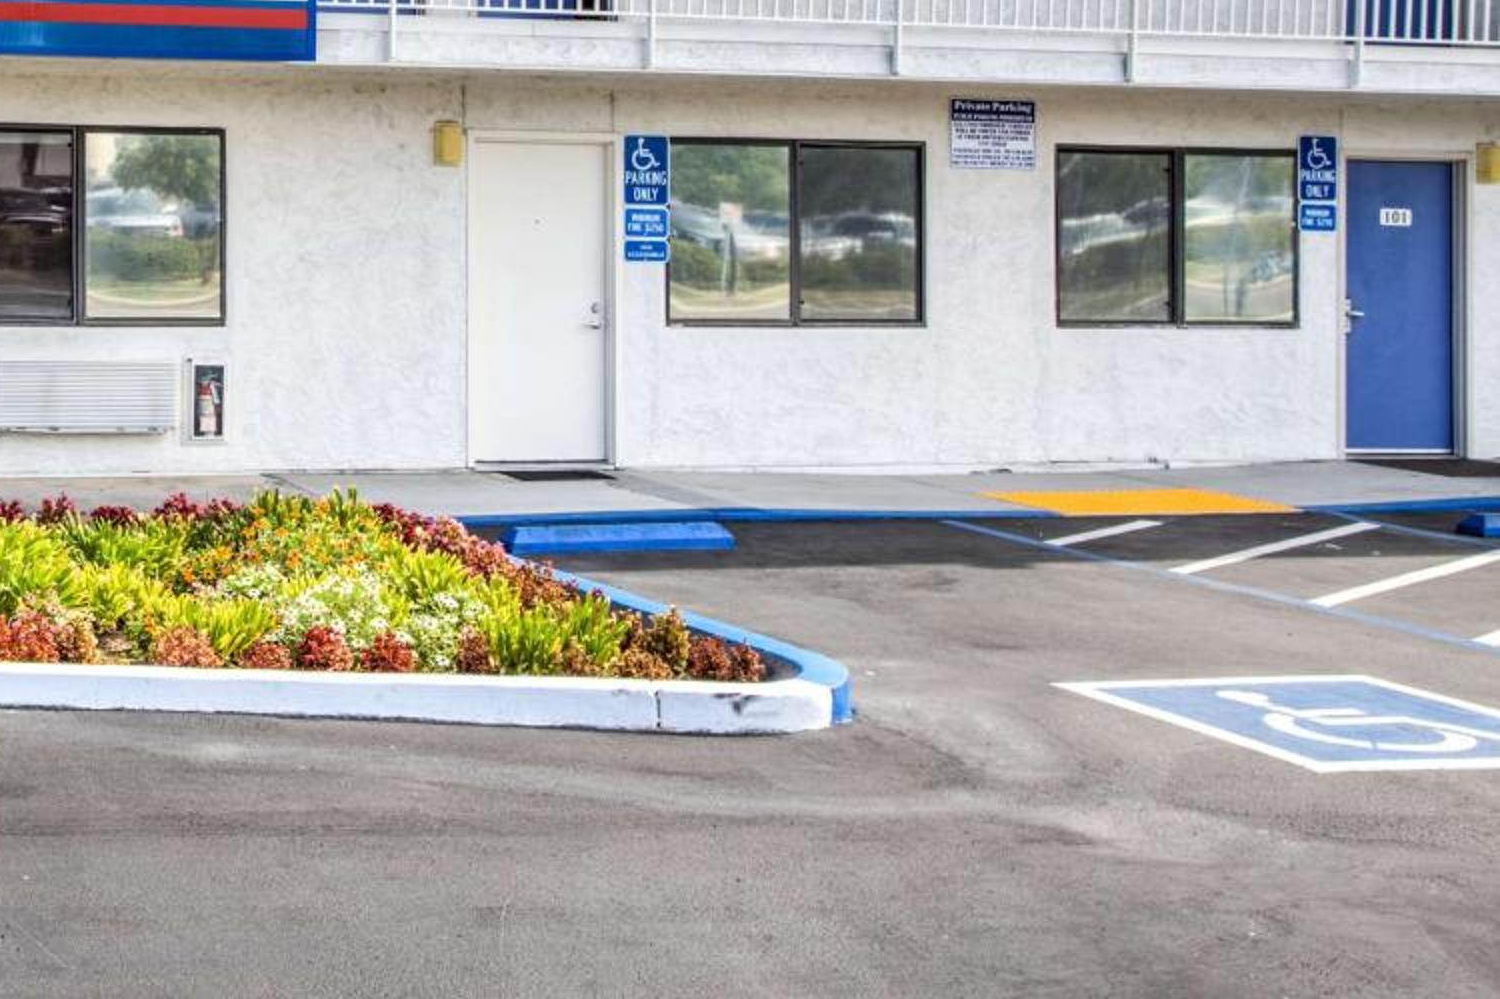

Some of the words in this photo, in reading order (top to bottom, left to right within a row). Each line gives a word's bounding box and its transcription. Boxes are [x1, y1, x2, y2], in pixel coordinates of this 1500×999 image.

[992, 102, 1033, 114] Parking
[625, 170, 667, 186] PARKING
[1300, 168, 1336, 184] PARKING
[632, 186, 659, 202] ONLY
[1305, 184, 1331, 198] ONLY
[1384, 210, 1407, 224] 101
